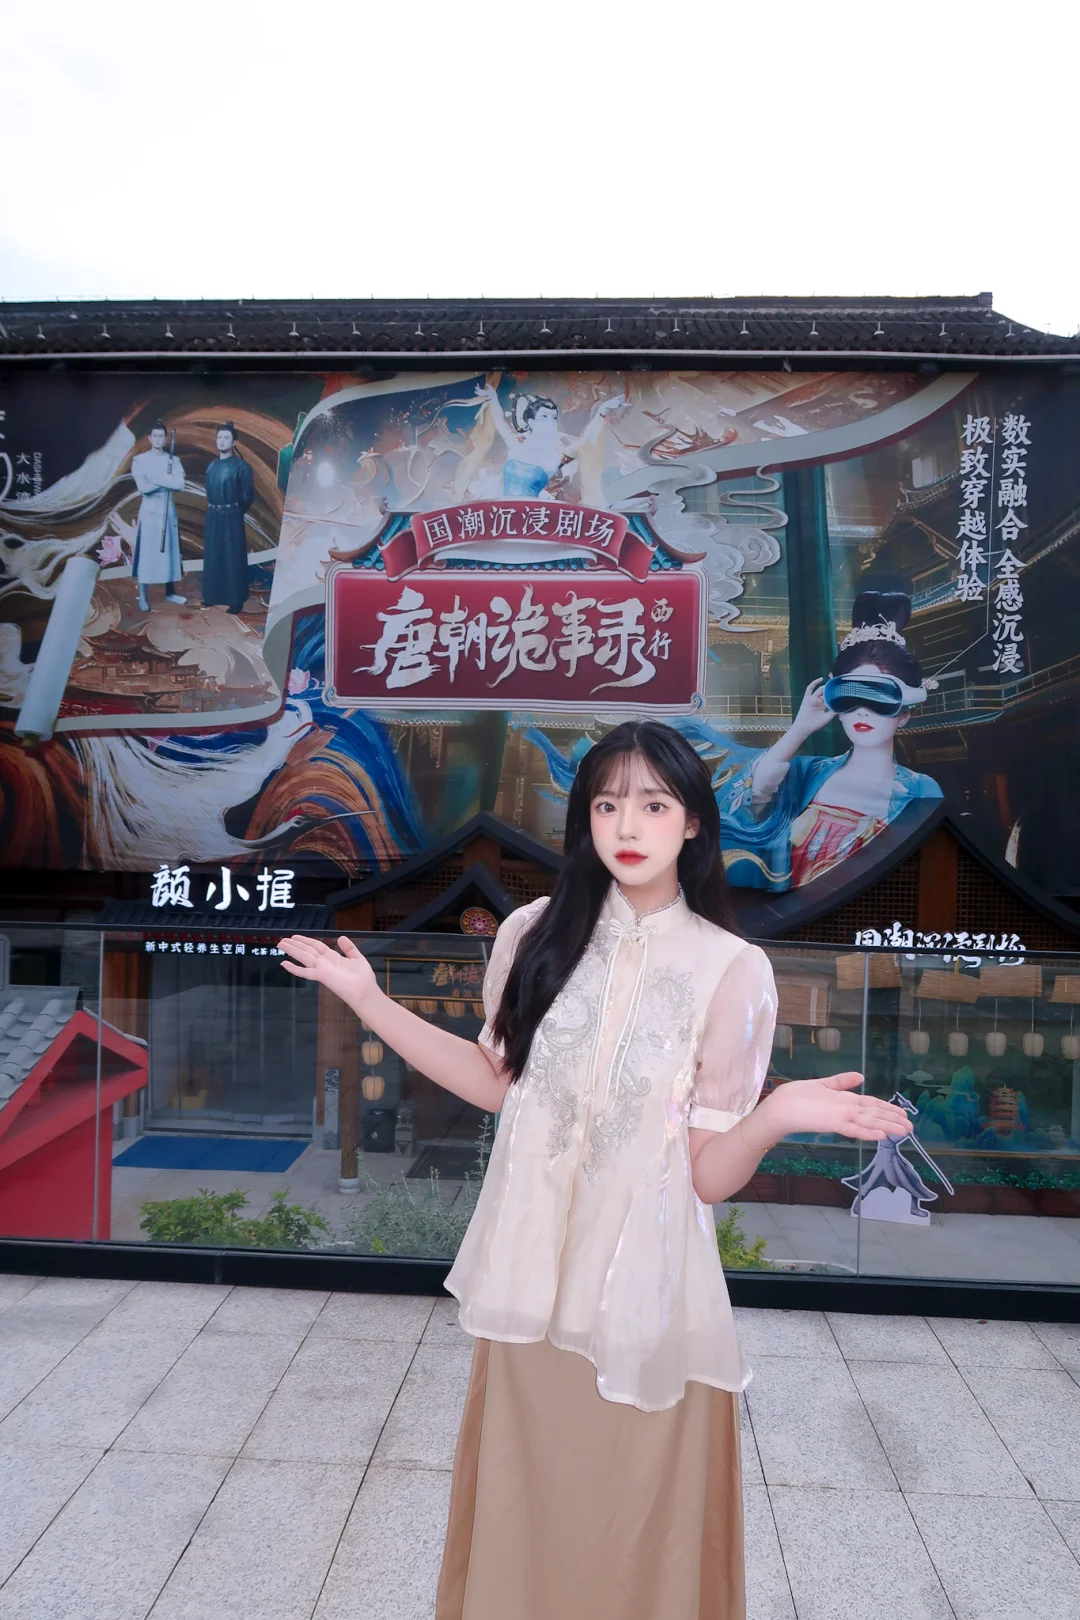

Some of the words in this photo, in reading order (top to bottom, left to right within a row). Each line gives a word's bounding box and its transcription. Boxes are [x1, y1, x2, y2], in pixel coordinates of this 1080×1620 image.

[956, 414, 993, 602] 极致穿越体验
[995, 413, 1032, 541] 数实融合
[423, 505, 615, 548] 国潮沉浸剧场
[353, 582, 656, 695] 唐朝诡事录
[646, 597, 674, 660] 西行
[992, 548, 1027, 674] 全感沉浸
[145, 941, 246, 955] 新中式轻养生空间
[428, 962, 486, 987] 唐朝诡
